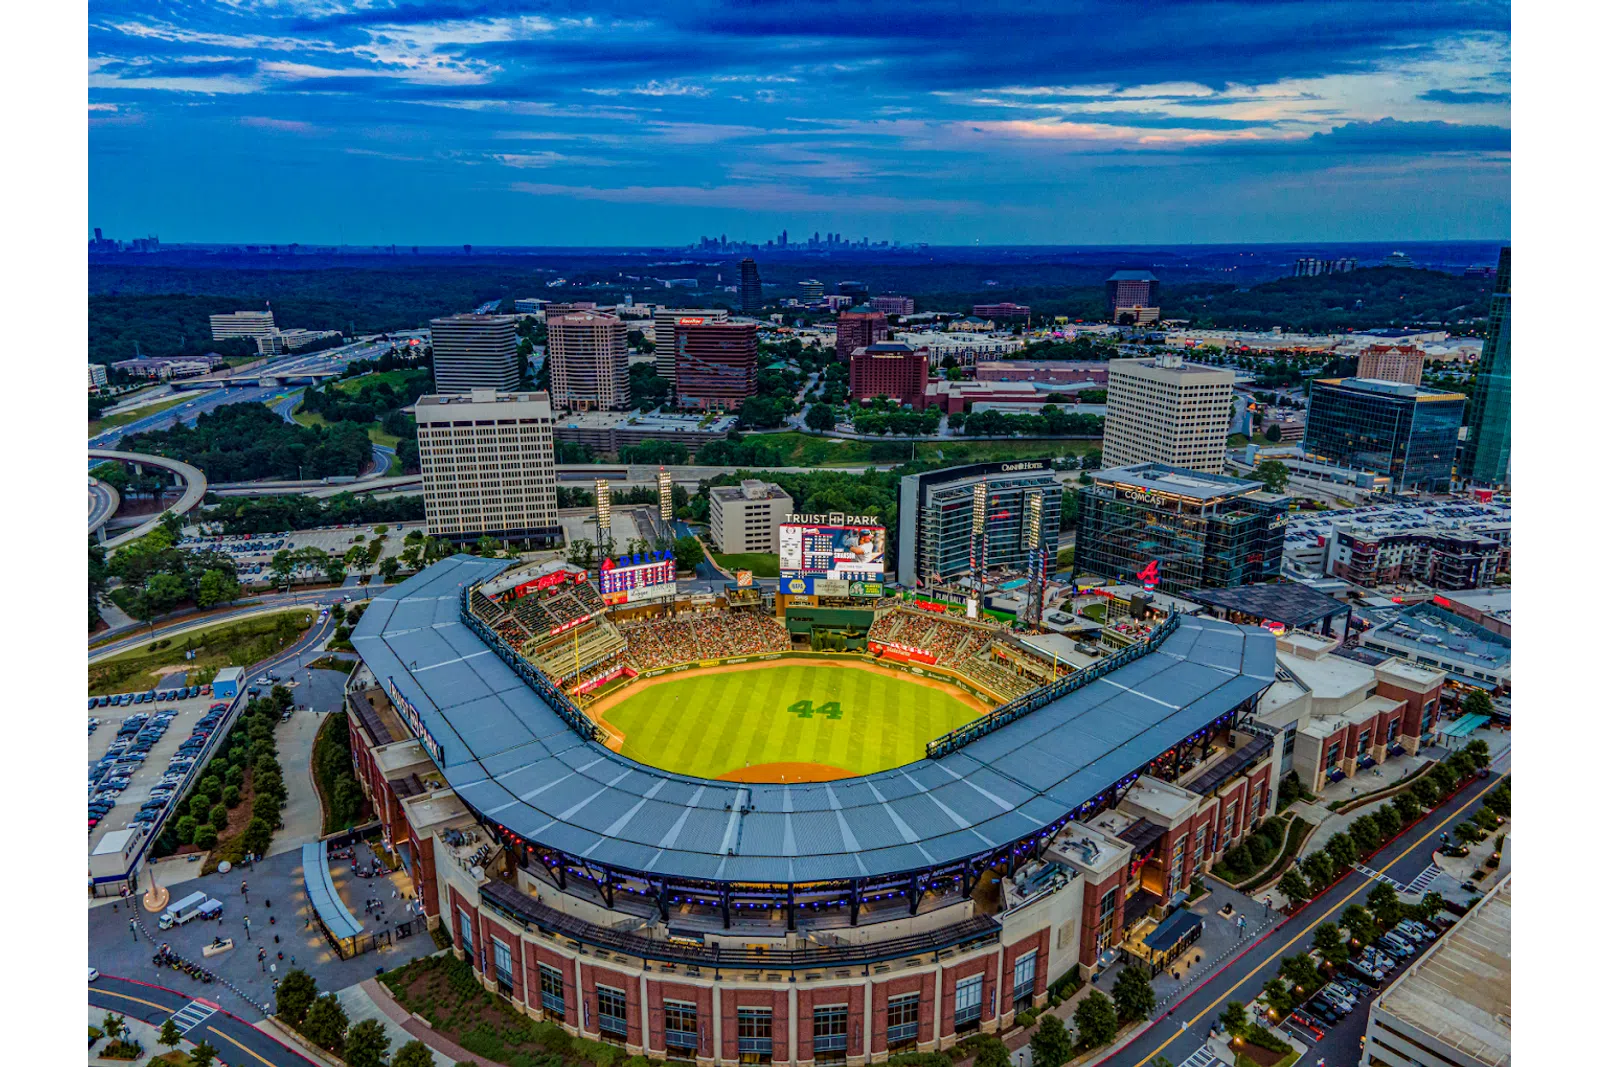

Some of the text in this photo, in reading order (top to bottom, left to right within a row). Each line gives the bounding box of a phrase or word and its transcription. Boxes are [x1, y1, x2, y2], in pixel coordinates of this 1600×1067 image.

[1125, 490, 1166, 506] COMCAST
[785, 513, 878, 525] TRUIST PARK
[619, 549, 673, 567] DELTA
[787, 700, 844, 720] 44
